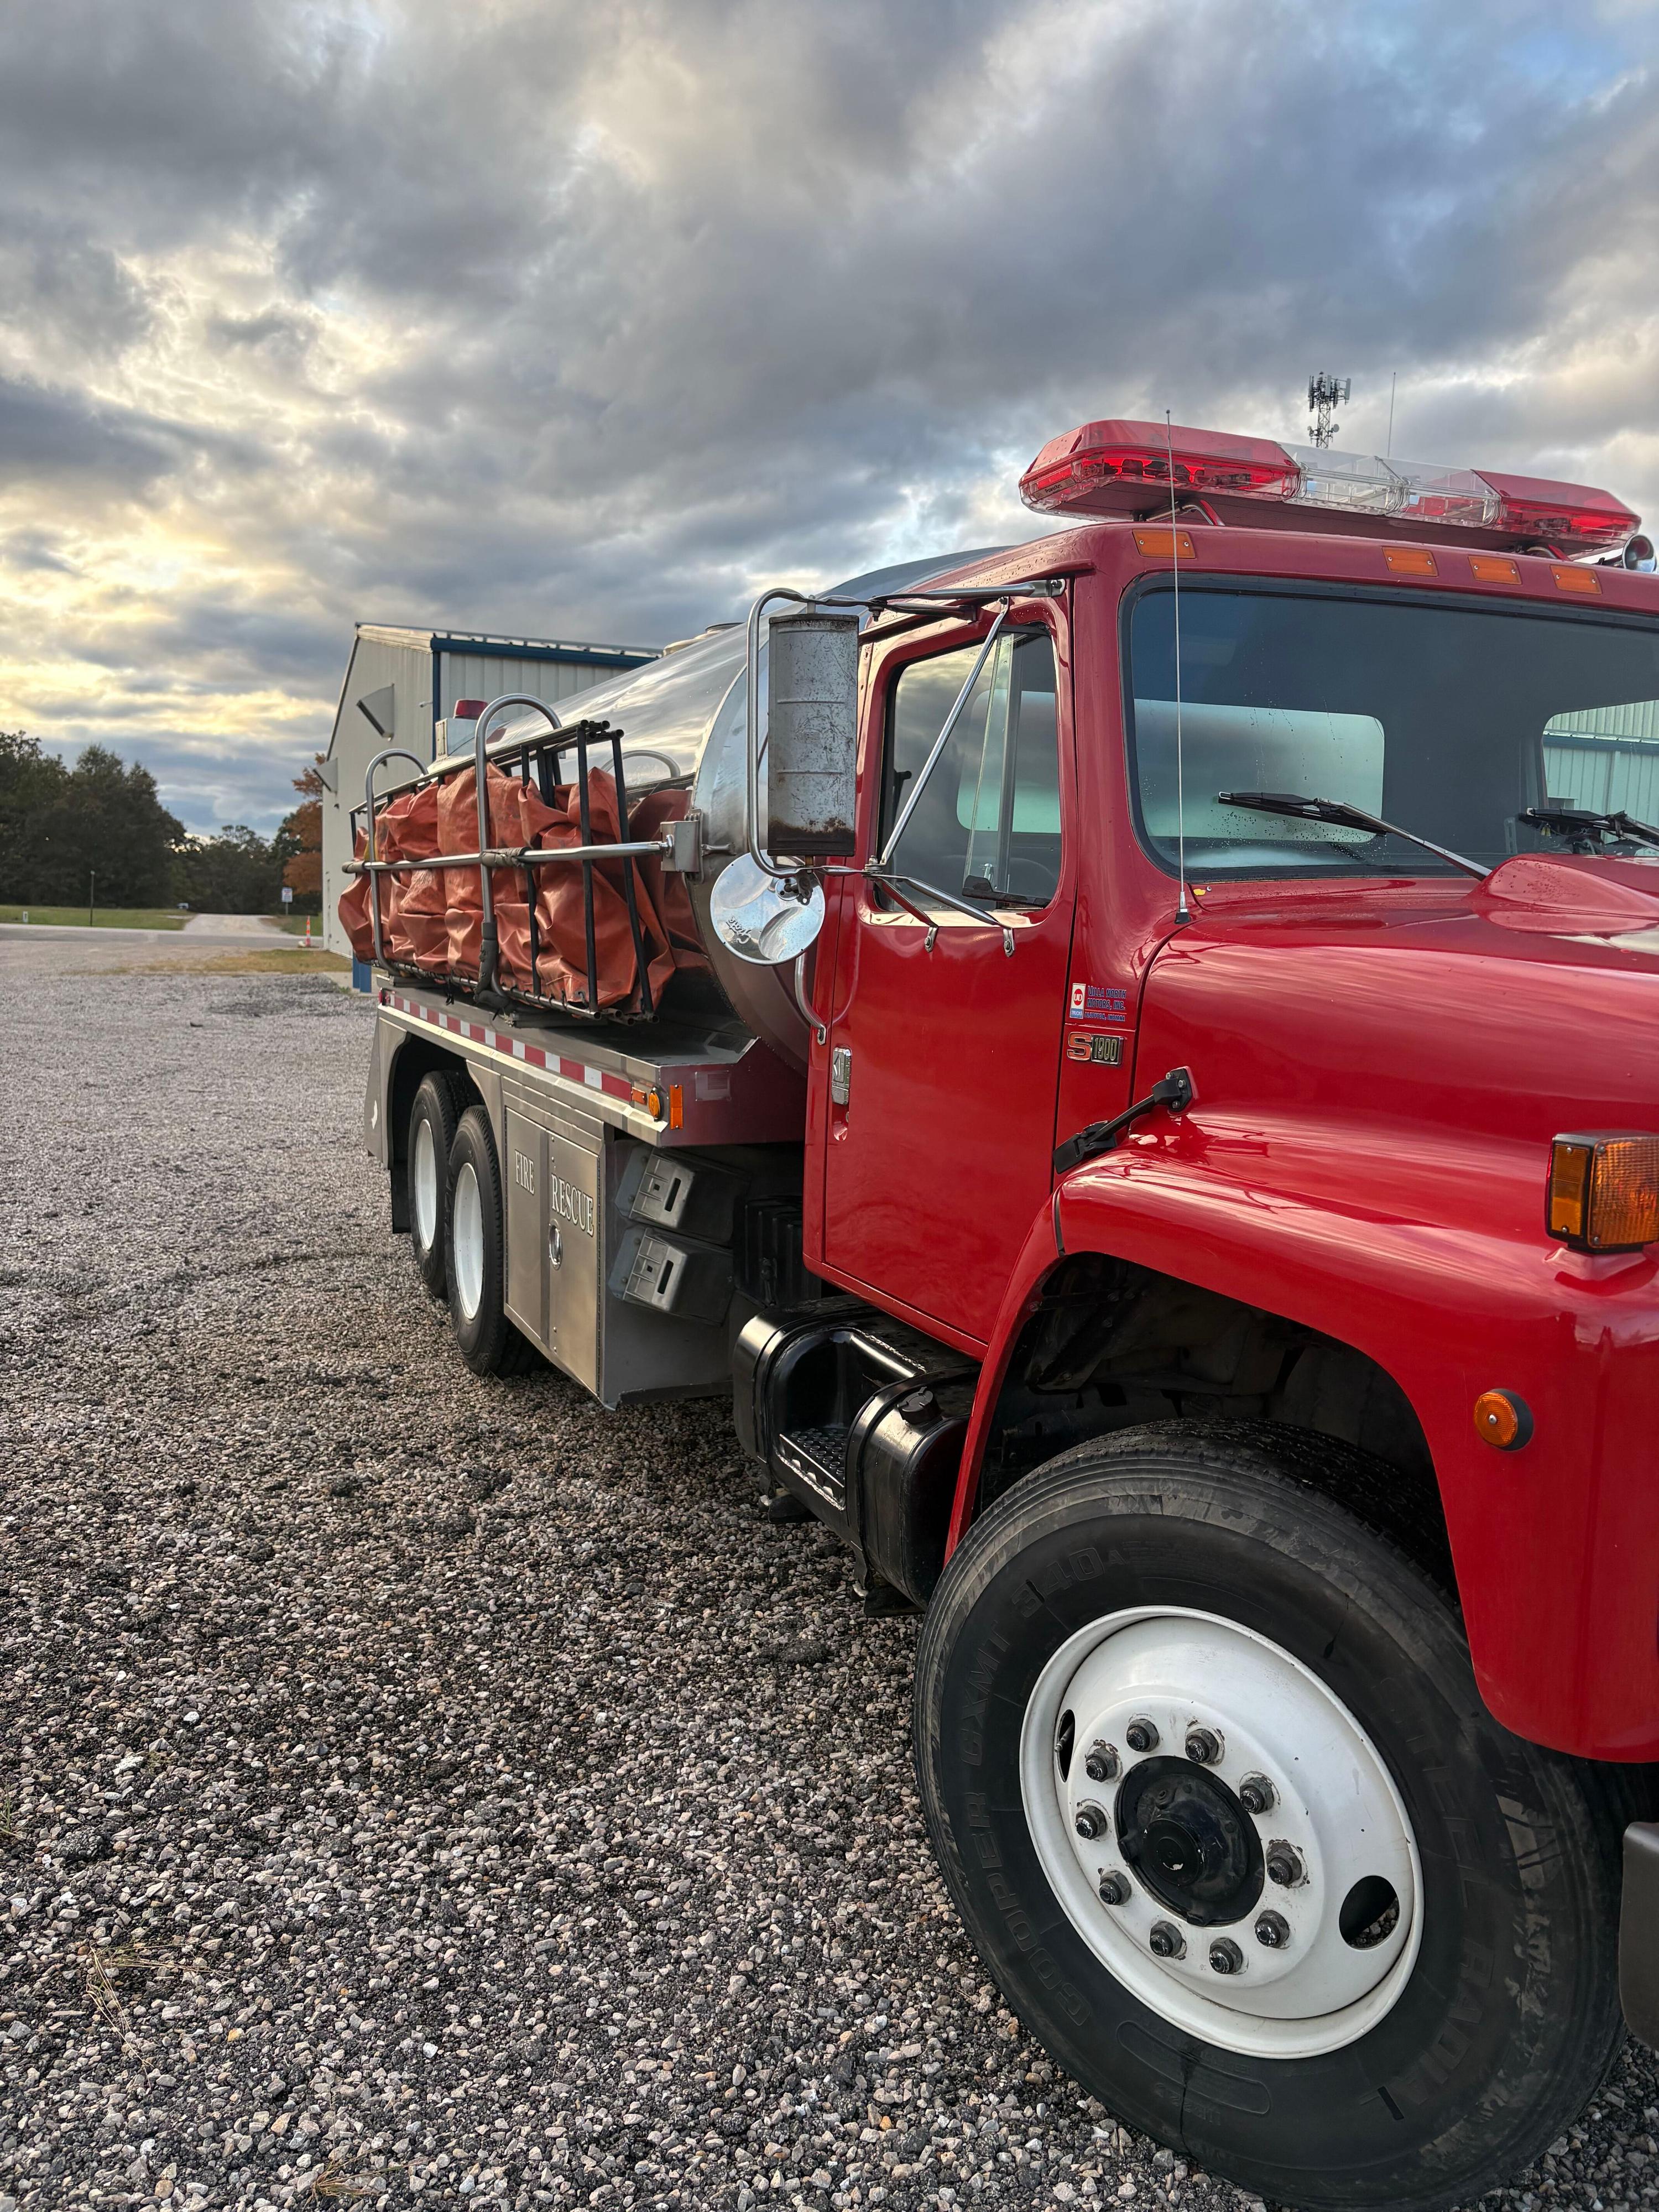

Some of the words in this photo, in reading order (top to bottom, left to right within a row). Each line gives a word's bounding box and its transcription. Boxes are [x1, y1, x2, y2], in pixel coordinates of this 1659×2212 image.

[1088, 985, 1104, 997] VILLA
[1106, 988, 1126, 999] NORTH
[1087, 998, 1112, 1010] MOTORS,
[1114, 1000, 1125, 1010] INC.
[515, 1149, 535, 1195] FIRE
[551, 1173, 594, 1237] RESCUE
